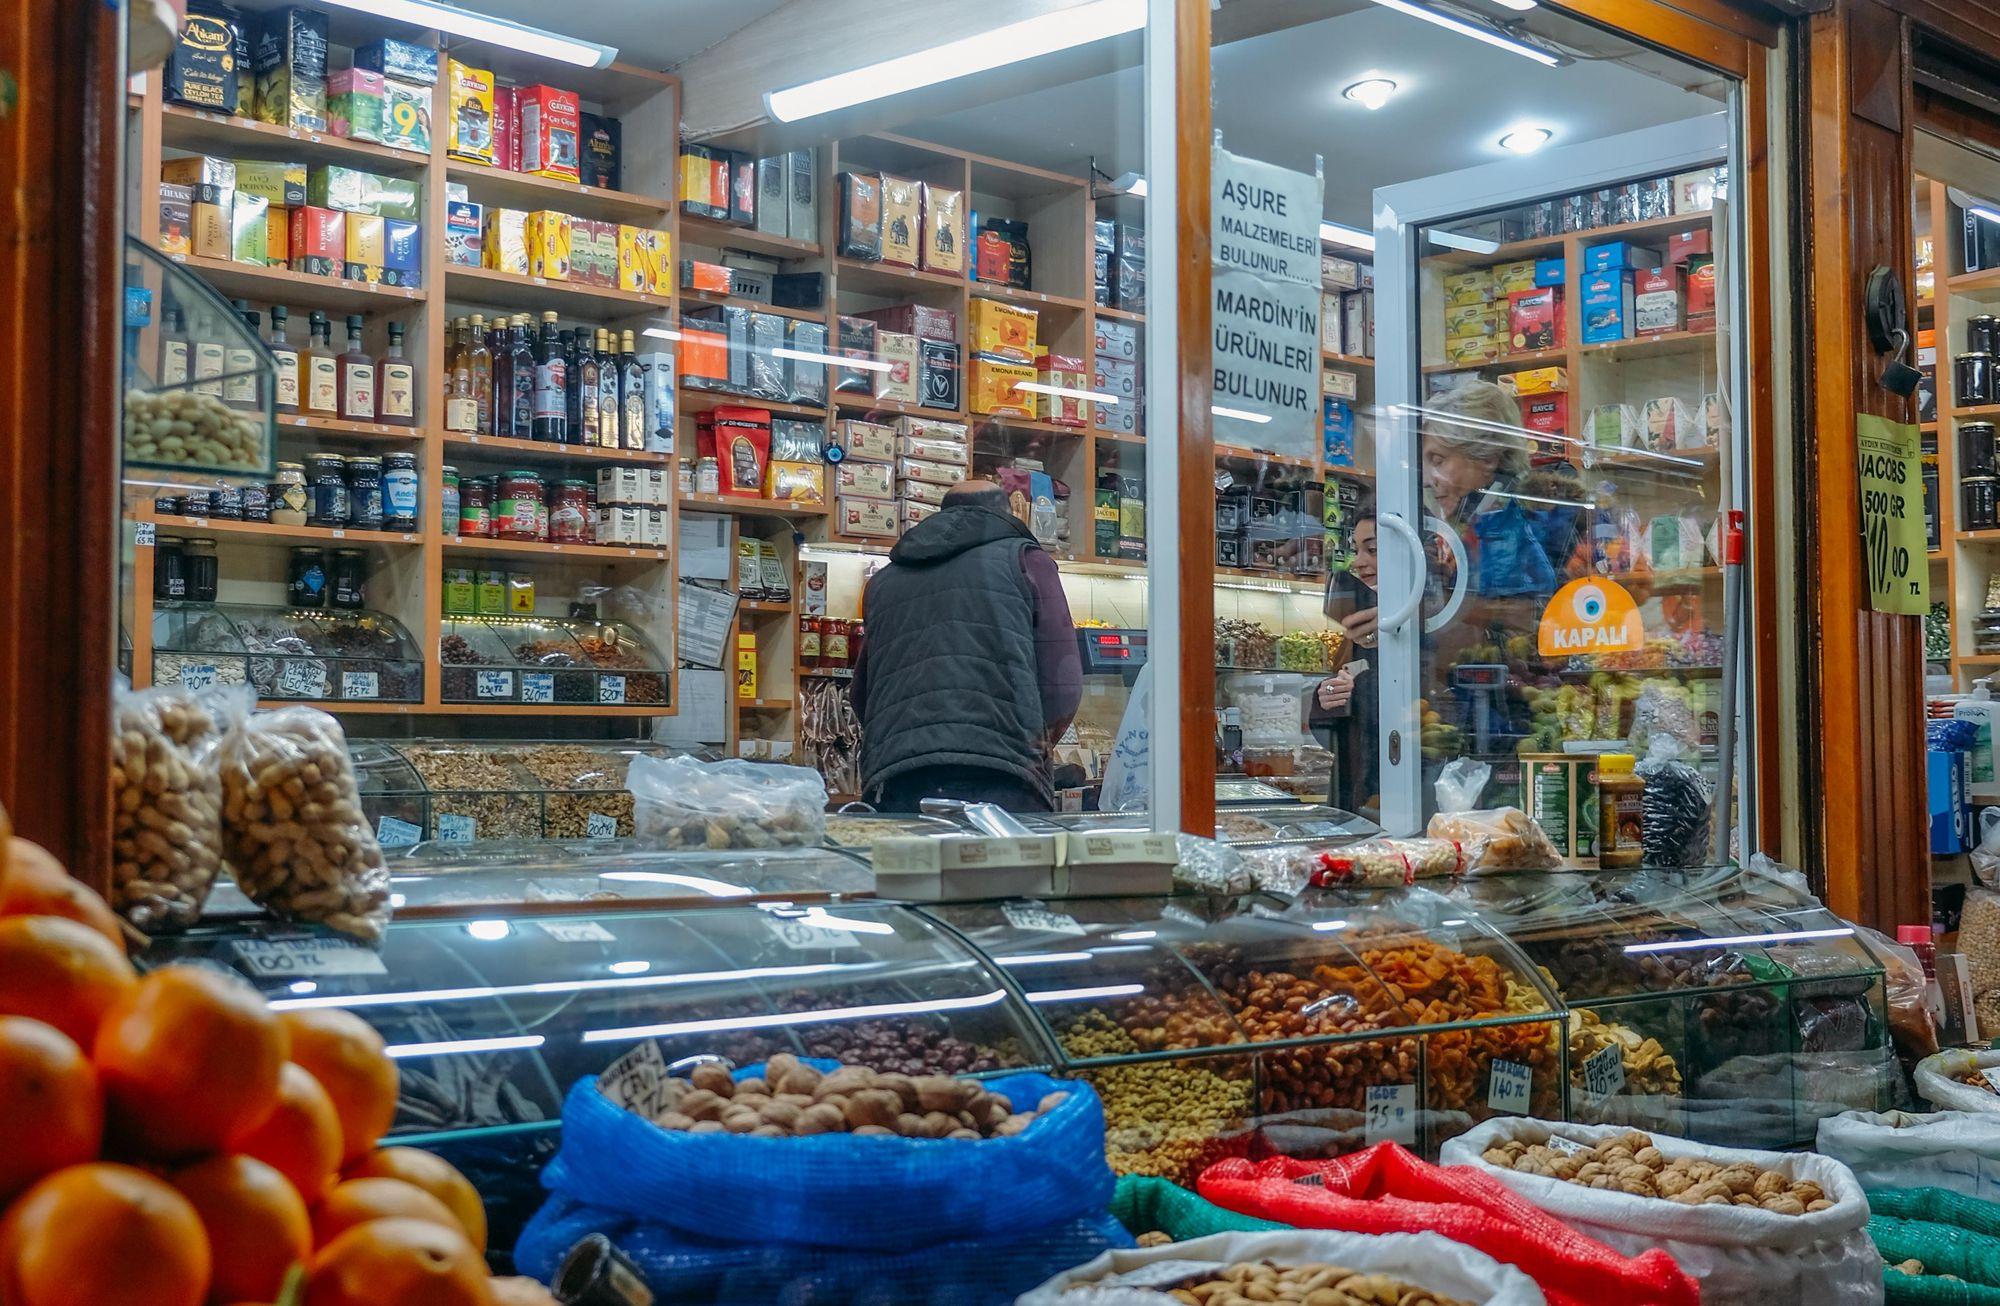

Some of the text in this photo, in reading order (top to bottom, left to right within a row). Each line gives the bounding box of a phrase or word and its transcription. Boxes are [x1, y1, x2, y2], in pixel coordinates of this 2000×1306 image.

[393, 103, 417, 136] 9
[1222, 179, 1288, 218] AŞURE
[1221, 216, 1316, 257] MALZEMELERİ
[994, 306, 1035, 321] EMONA BRAND
[1217, 289, 1317, 336] MARDİN'İN
[1215, 323, 1313, 374] ÜRÜNLERİ
[991, 367, 1033, 378] EMONA BRAND
[1860, 453, 1906, 485] JACOBS
[1865, 490, 1905, 519] 500 GR
[1909, 581, 1920, 596] TL
[1553, 625, 1628, 649] KAPALI
[1514, 1084, 1525, 1098] TL
